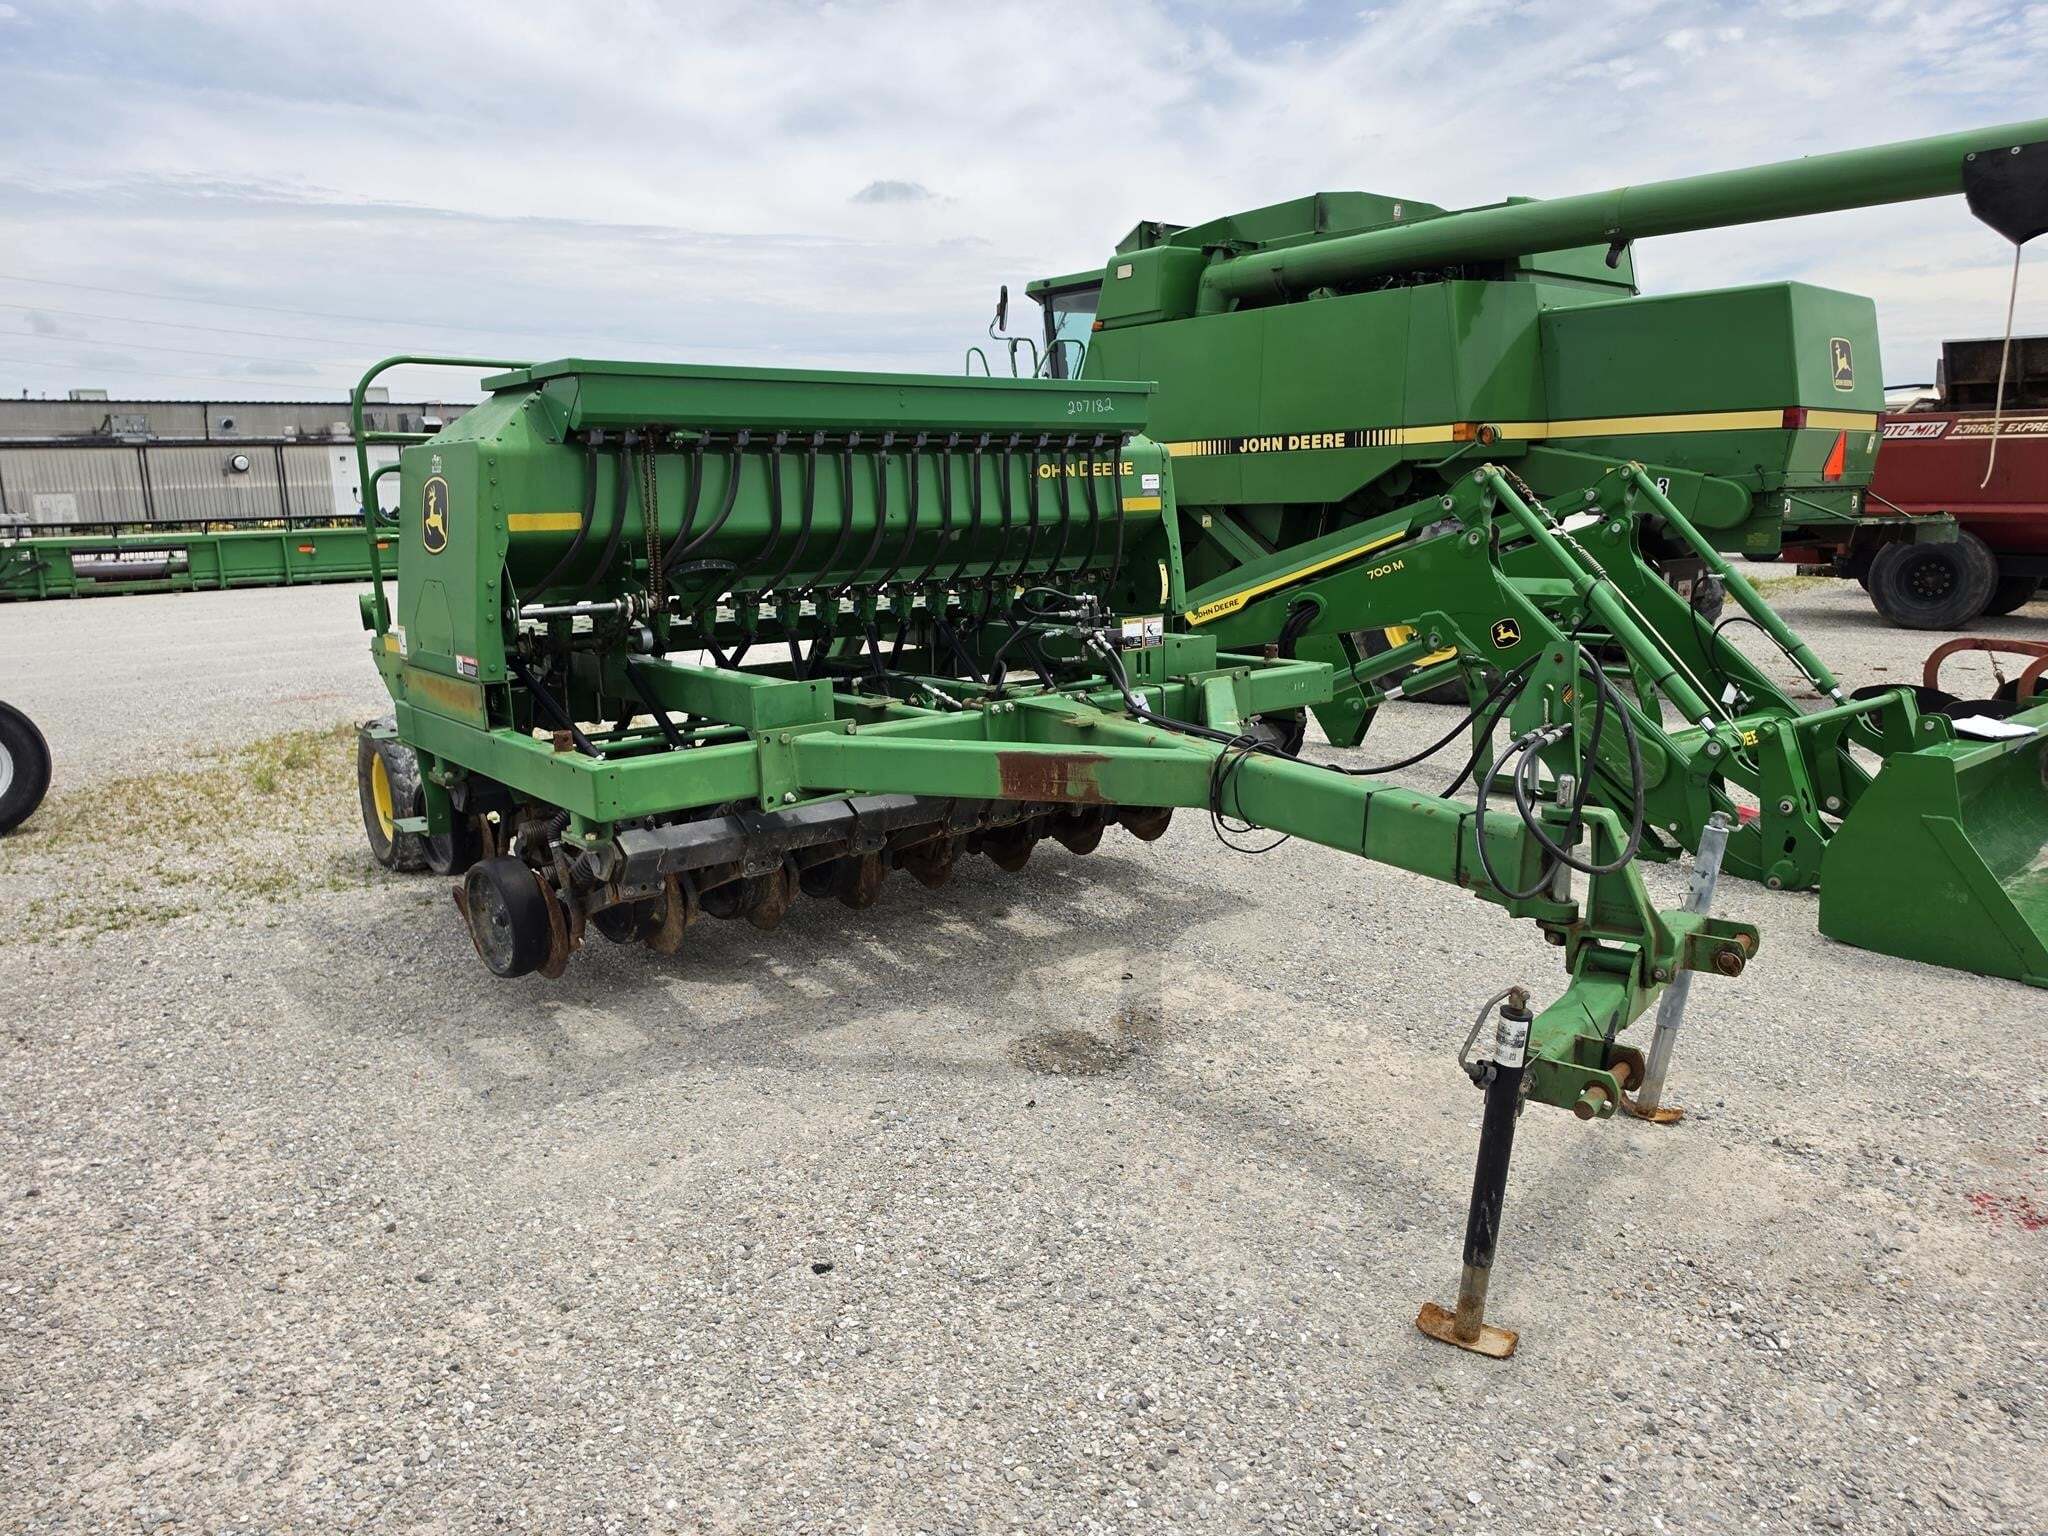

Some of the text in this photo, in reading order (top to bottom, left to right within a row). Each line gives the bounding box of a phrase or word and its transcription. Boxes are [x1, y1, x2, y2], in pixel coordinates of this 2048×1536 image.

[1068, 397, 1114, 414] 207182
[1239, 432, 1345, 453] JOHN DEERE
[1036, 463, 1076, 478] OHN
[1366, 559, 1405, 580] 700 M
[1213, 598, 1240, 612] DEERE
